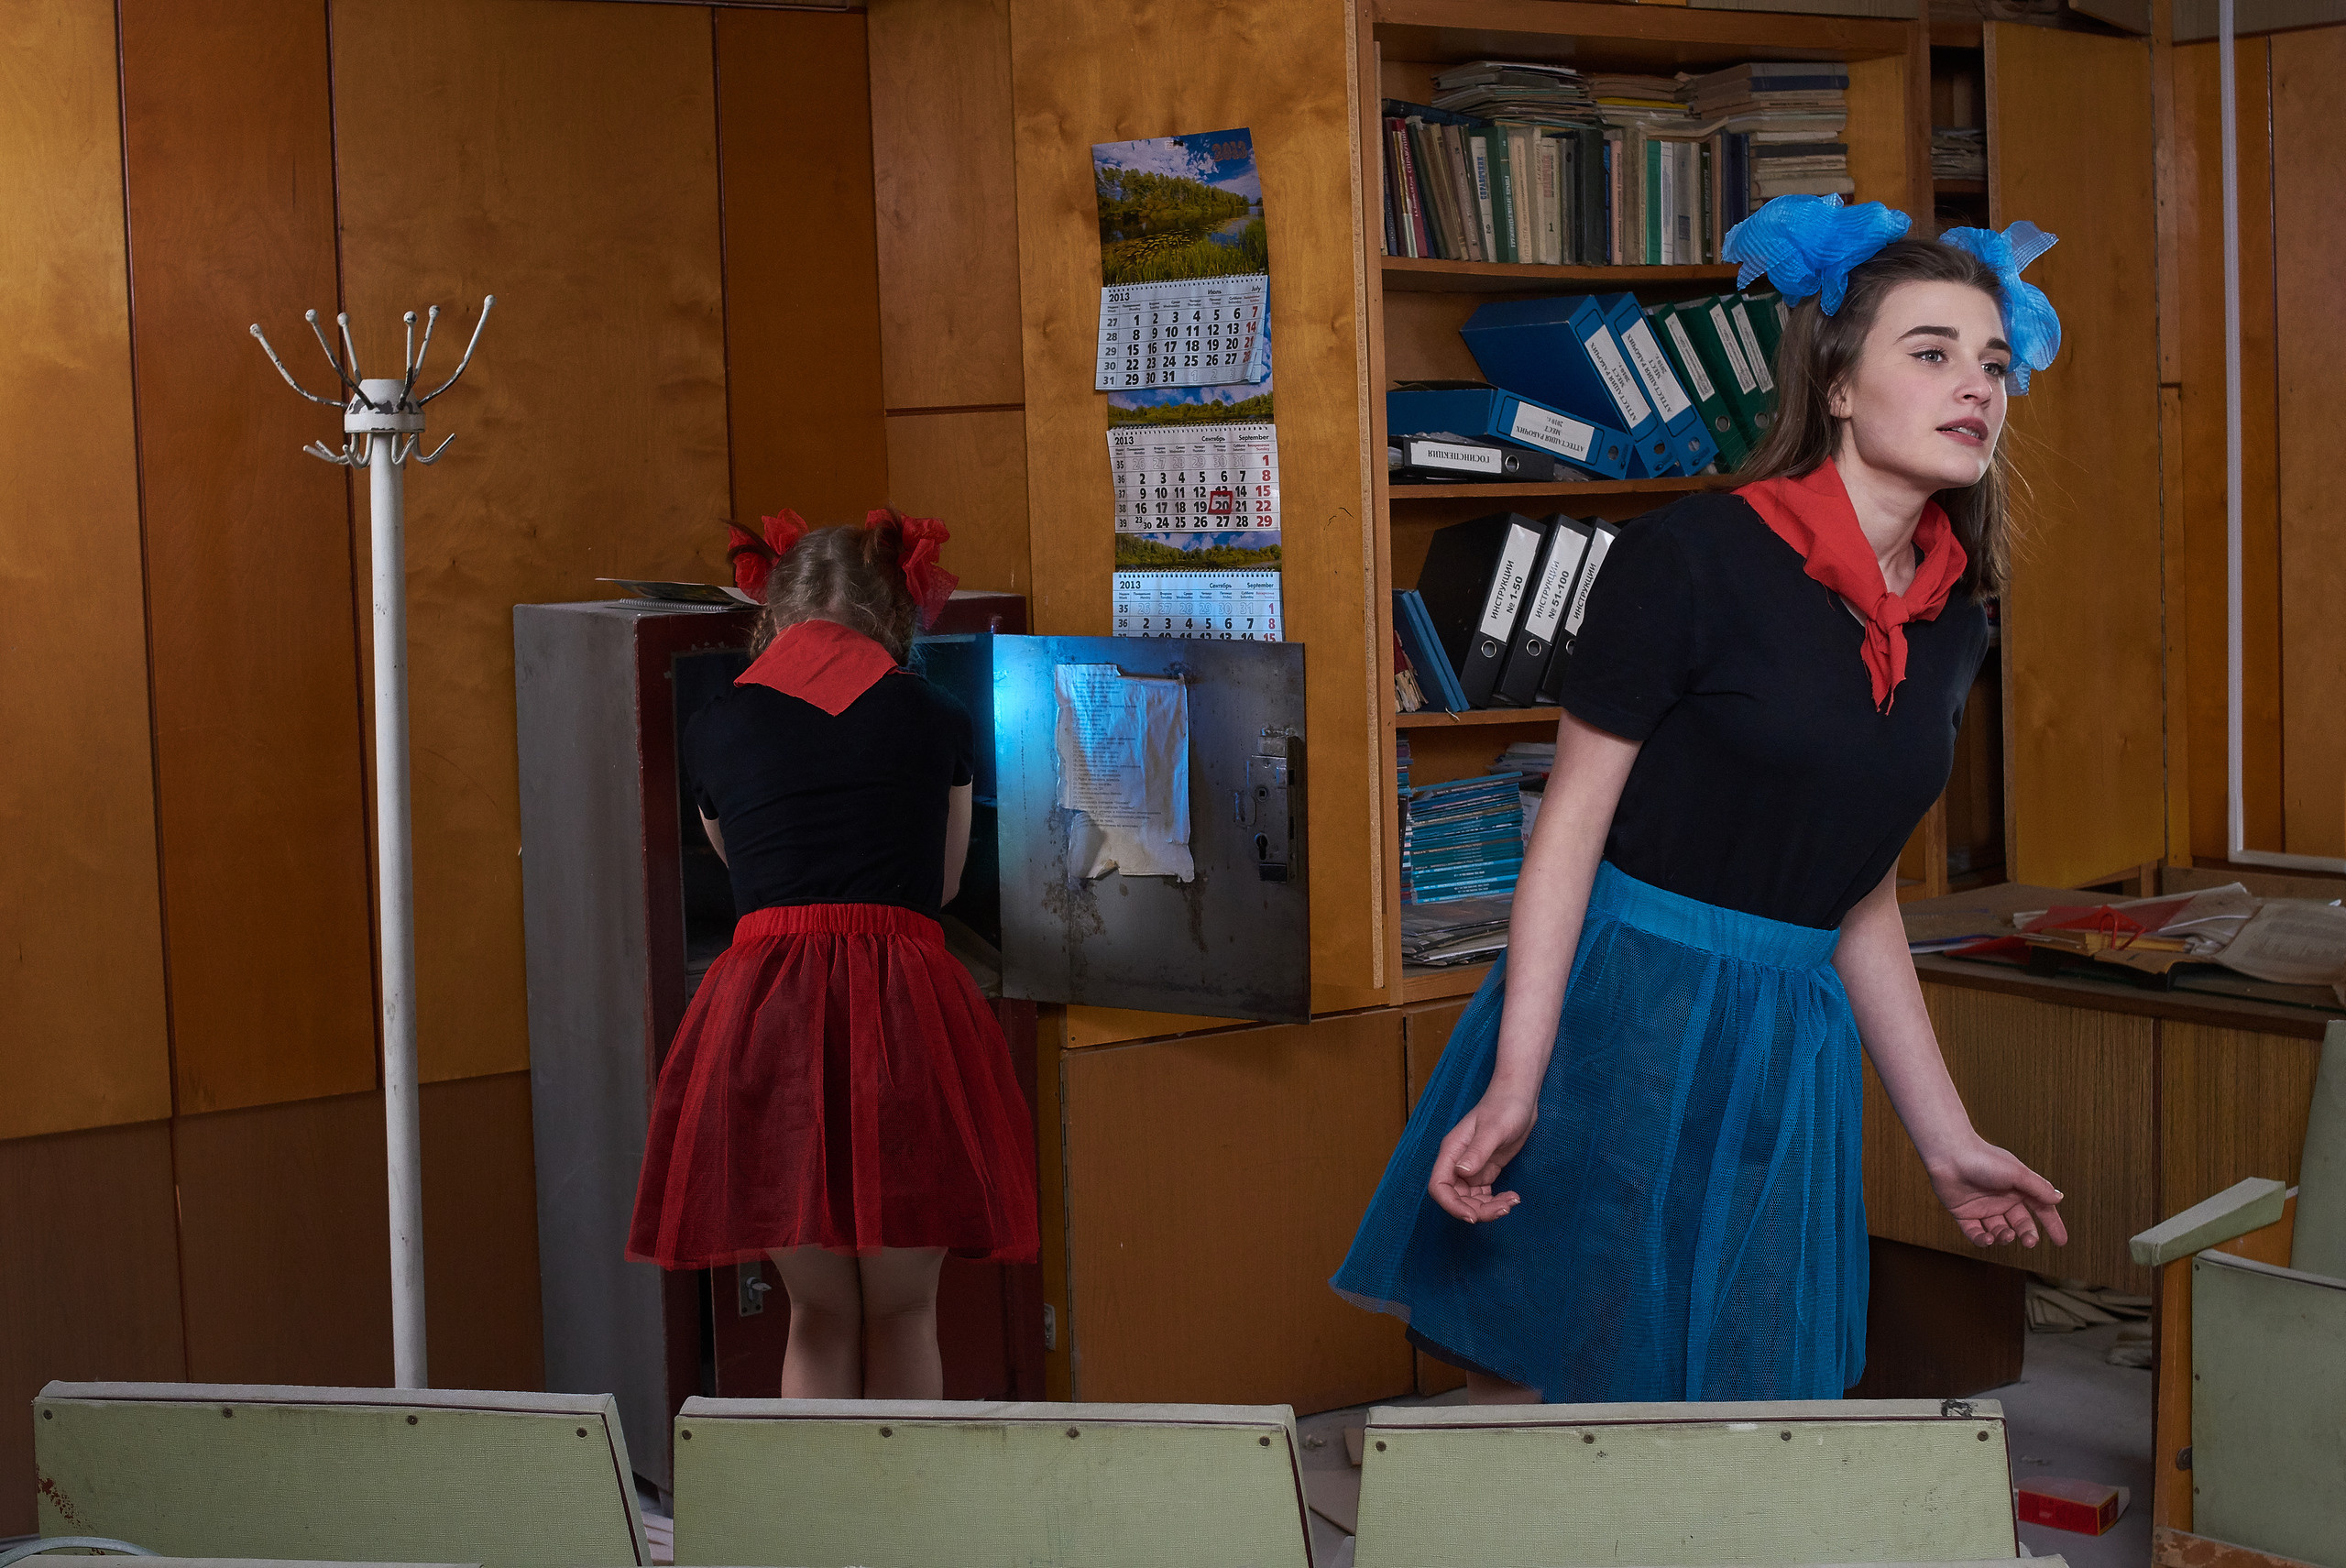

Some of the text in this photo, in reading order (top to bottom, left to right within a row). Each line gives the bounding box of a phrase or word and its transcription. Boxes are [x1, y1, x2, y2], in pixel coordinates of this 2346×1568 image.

[1211, 141, 1248, 161] 2013
[1476, 157, 1486, 200] СПРАВОЧНИК
[1109, 292, 1130, 302] 2013
[1107, 306, 1257, 326] 27 1 2 3 4 5 6 7
[1107, 322, 1255, 341] 28 8 9 10 11 12 13 14
[1127, 345, 1139, 355] 15
[1148, 343, 1157, 354] 16
[1165, 341, 1177, 352] 17
[1186, 340, 1199, 351] 18
[1208, 339, 1219, 350] 19
[1226, 338, 1238, 349] 20
[1244, 337, 1254, 348] 21
[1104, 362, 1115, 370] 30
[1126, 359, 1138, 370] 22
[1147, 357, 1156, 368] 23
[1163, 356, 1176, 367] 24
[1185, 356, 1198, 367] 25
[1206, 354, 1218, 366] 26
[1225, 353, 1237, 364] 27
[1649, 359, 1662, 379] МЕСТ
[1657, 360, 1667, 374] 2010
[1103, 377, 1114, 385] 31
[1125, 374, 1138, 385] 29
[1146, 372, 1155, 383] 30
[1163, 371, 1175, 381] 31
[1611, 368, 1626, 388] МЕСТ
[1620, 368, 1630, 383] 2010
[1627, 334, 1673, 412] АТТЕСТАЦИЯ РАБОЧИХ
[1591, 343, 1639, 421] АТТЕСТАЦИЯ РАБОЧИХ
[1544, 425, 1563, 436] МЕСТ
[1551, 418, 1563, 428] 2010
[1115, 436, 1134, 444] 2013
[1516, 425, 1584, 453] АТТЕСТАЦИЯ РАБОЧИХ
[1116, 455, 1269, 469] 35 26 27 28 29 30 31 1
[1428, 449, 1490, 463] ГОСИНСПЕКЦИЯ
[1140, 474, 1146, 484] 2
[1161, 473, 1166, 484] 3
[1178, 472, 1185, 483] 4
[1200, 472, 1205, 482] 5
[1221, 471, 1227, 482] 6
[1240, 471, 1246, 481] 7
[1262, 470, 1270, 481] 8
[1140, 488, 1146, 499] 9
[1155, 488, 1168, 499] 10
[1175, 487, 1185, 498] 11
[1193, 487, 1206, 498] 12
[1235, 486, 1246, 497] 14
[1255, 485, 1270, 496] 15
[1119, 500, 1271, 514] 38 16 17 18 19 20 21 22
[1157, 517, 1169, 528] 24
[1176, 517, 1186, 528] 25
[1194, 516, 1208, 527] 26
[1217, 516, 1230, 527] 27
[1236, 516, 1248, 527] 28
[1257, 516, 1272, 527] 29
[1491, 560, 1514, 620] ИНСТРУКЦИИ
[1507, 576, 1523, 614] № 1-50
[1535, 560, 1560, 618] ИНСТРУКЦИИ
[1548, 570, 1569, 619] № 51-100
[1573, 563, 1596, 620] ИНСТРУКЦИИ
[1119, 603, 1274, 614] 35 26 27 28 29 30 31 1
[1118, 618, 1276, 630] 36 2 3 4 5 6 7 8
